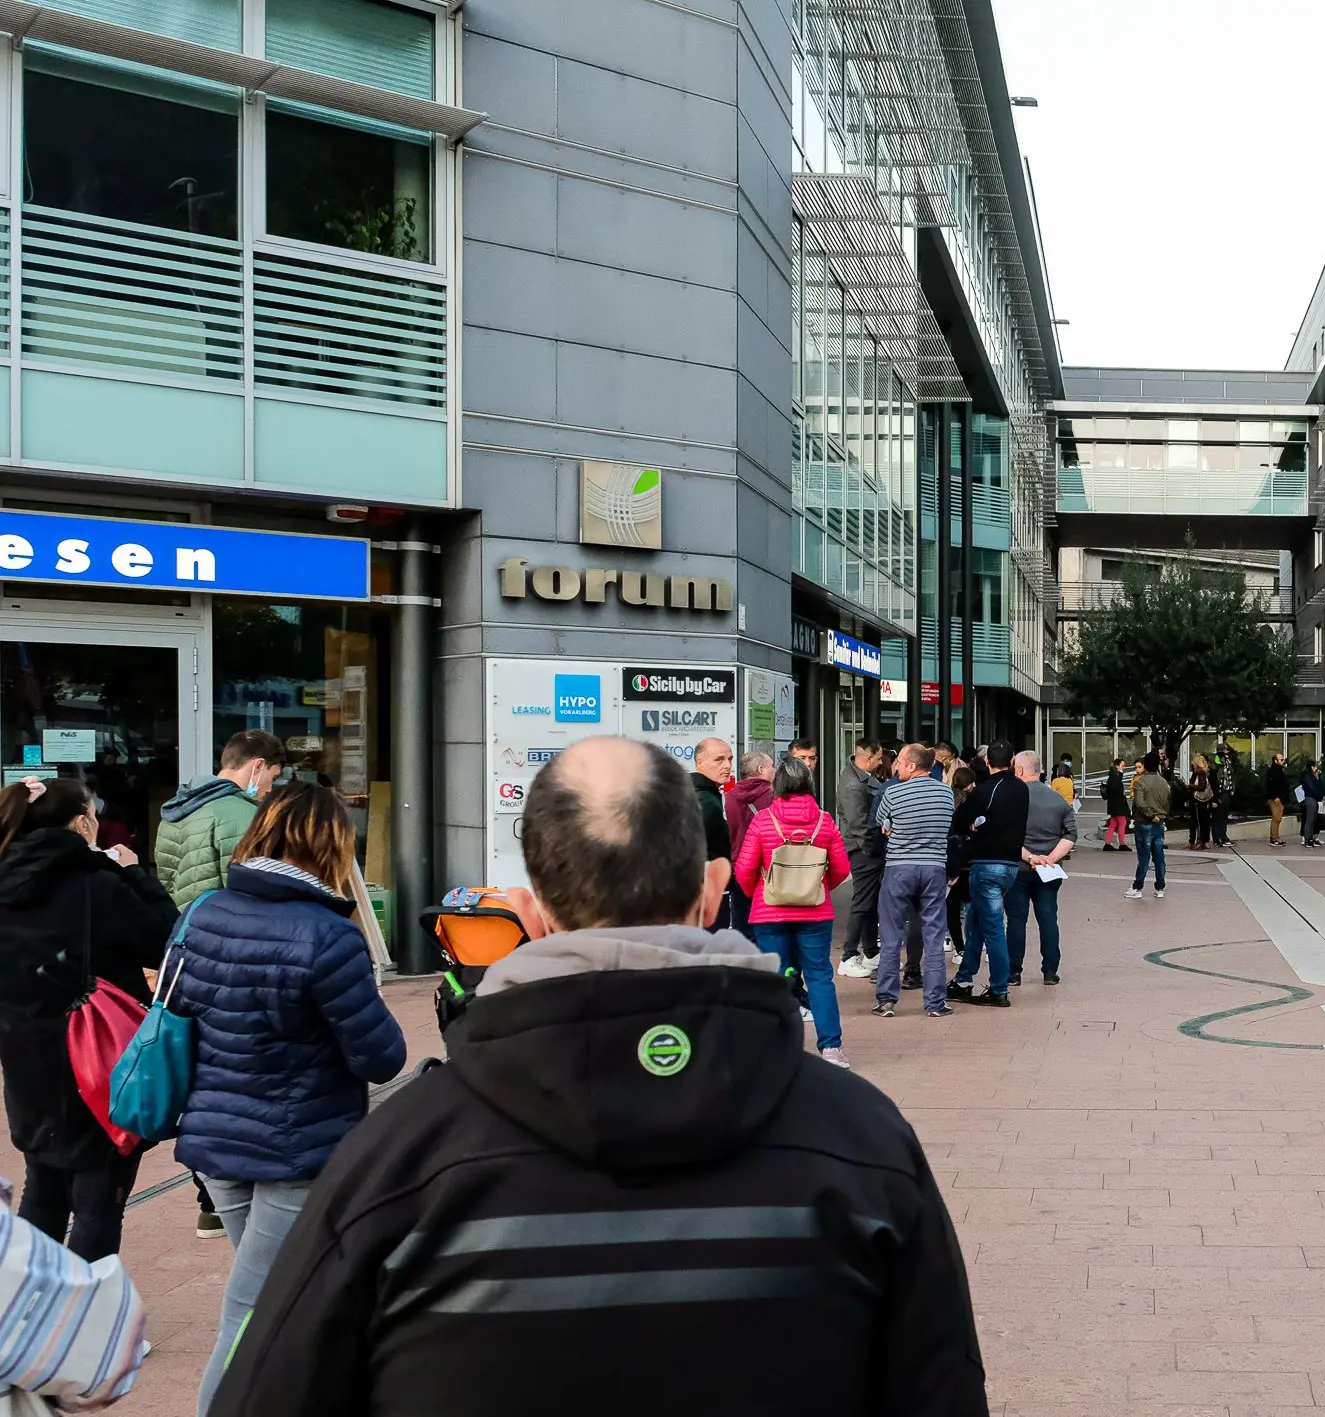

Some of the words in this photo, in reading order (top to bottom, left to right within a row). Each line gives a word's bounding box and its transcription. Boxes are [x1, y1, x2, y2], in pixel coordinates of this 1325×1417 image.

[0, 534, 217, 582] esen
[498, 558, 736, 612] forum
[559, 696, 597, 708] HYPO
[511, 705, 551, 716] LEASING
[662, 710, 718, 726] SILCART
[529, 752, 557, 761] BR
[665, 743, 697, 760] trog
[499, 783, 524, 800] GS
[500, 800, 524, 808] GROUP
